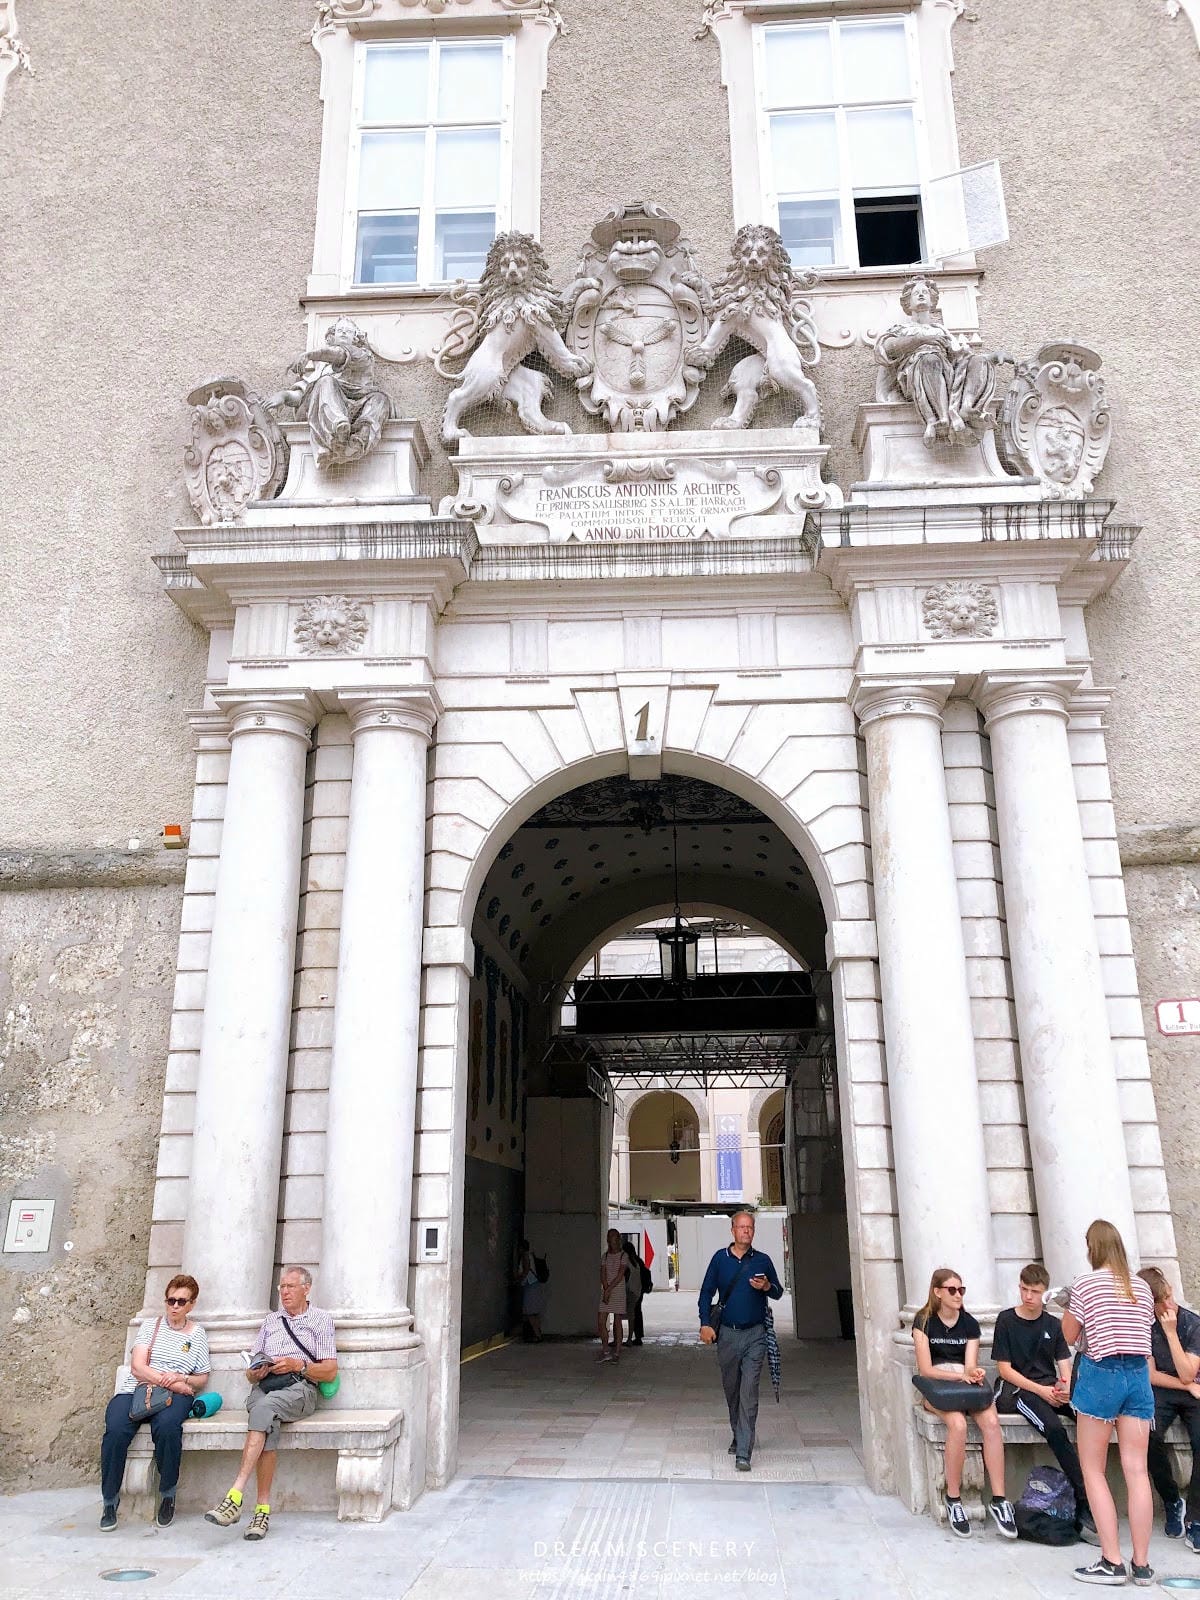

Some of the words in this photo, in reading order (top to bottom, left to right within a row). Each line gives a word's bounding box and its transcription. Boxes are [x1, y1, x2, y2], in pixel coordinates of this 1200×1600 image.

[539, 485, 611, 501] FRANCISCUS
[615, 483, 678, 497] ANTONIUS
[683, 483, 741, 495] ARCHIEPS
[536, 502, 548, 511] ET
[549, 500, 591, 511] PRINCEPS
[686, 497, 697, 506] DE
[701, 496, 746, 506] HARRACH
[559, 510, 610, 519] PALATIUM
[615, 509, 644, 517] INTUS
[650, 508, 665, 516] ET
[668, 507, 695, 515] FORIS
[585, 526, 621, 540] ANNO
[649, 525, 696, 538] MDCCX
[1176, 1002, 1188, 1022] 1
